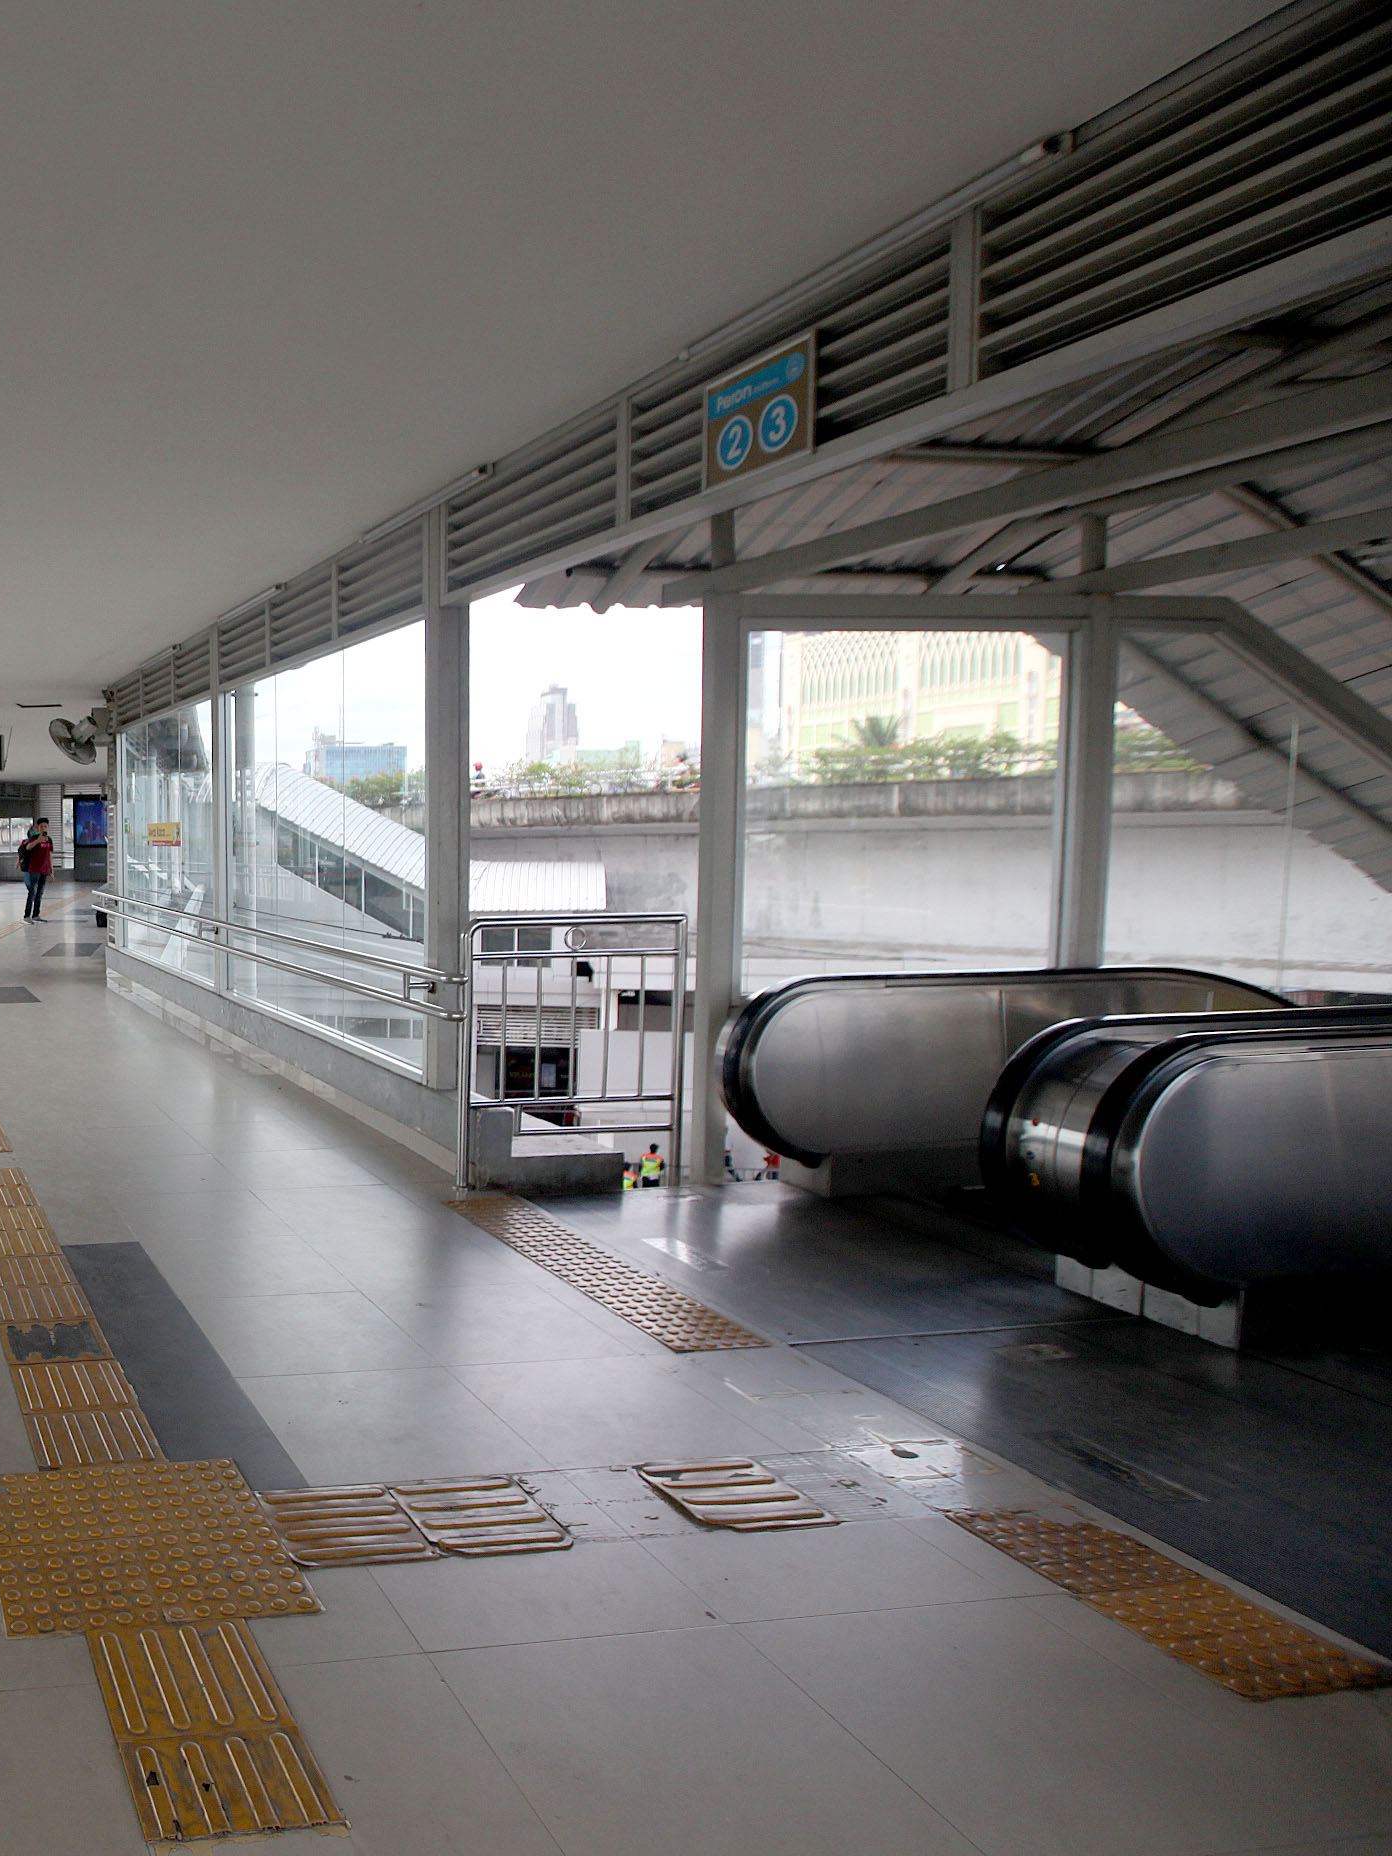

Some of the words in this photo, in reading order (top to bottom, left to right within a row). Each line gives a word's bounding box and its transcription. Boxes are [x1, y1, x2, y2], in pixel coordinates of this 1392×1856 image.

[716, 385, 753, 413] Peron
[727, 424, 743, 461] 2
[769, 406, 787, 442] 3
